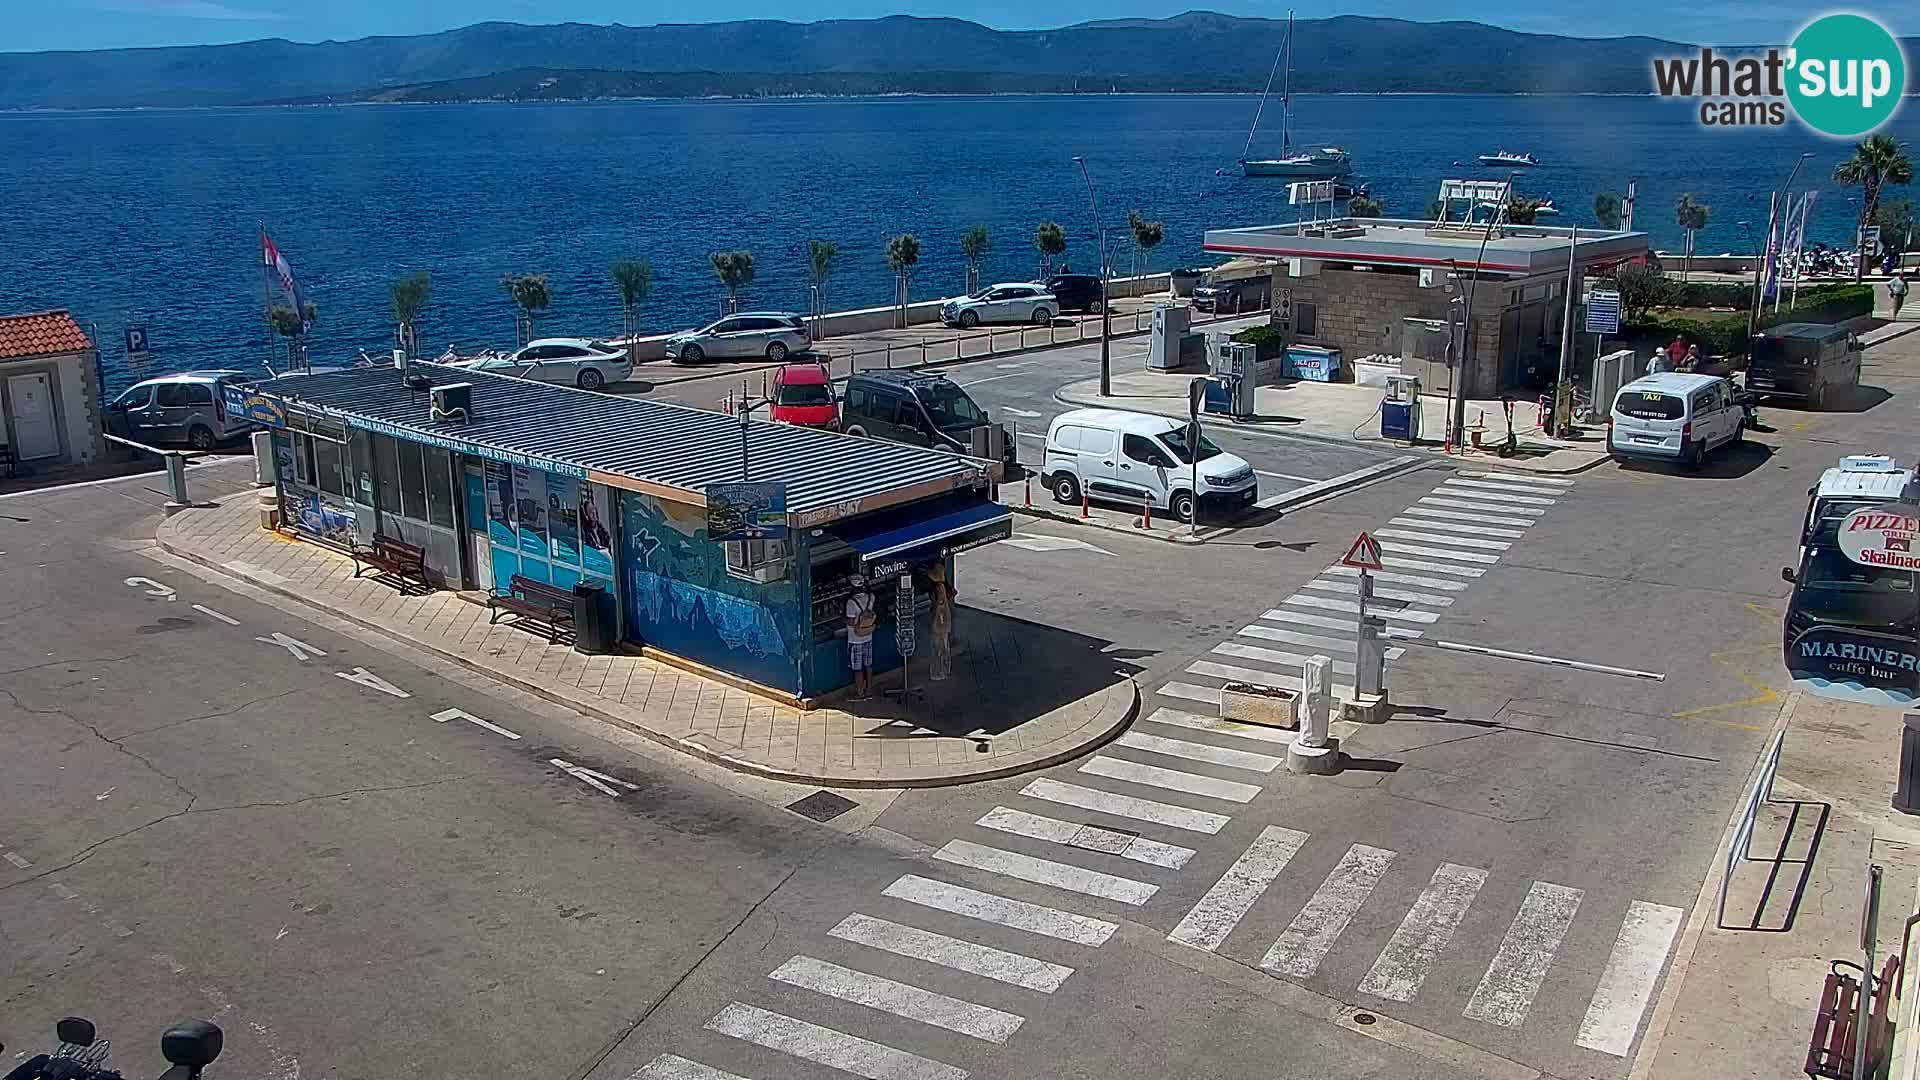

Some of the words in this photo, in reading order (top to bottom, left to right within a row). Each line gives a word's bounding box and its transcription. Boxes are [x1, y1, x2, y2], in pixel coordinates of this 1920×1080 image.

[130, 331, 142, 349] P
[1642, 393, 1662, 401] TAXI
[479, 446, 493, 457] BUS
[494, 450, 526, 464] STATION
[528, 457, 554, 471] TICKET
[555, 462, 582, 476] OFFICE
[1848, 514, 1920, 532] PIZZE
[1882, 530, 1917, 540] GRILL
[1800, 641, 1920, 673] MARINER
[1828, 662, 1866, 675] caffe
[1870, 665, 1896, 679] bar
